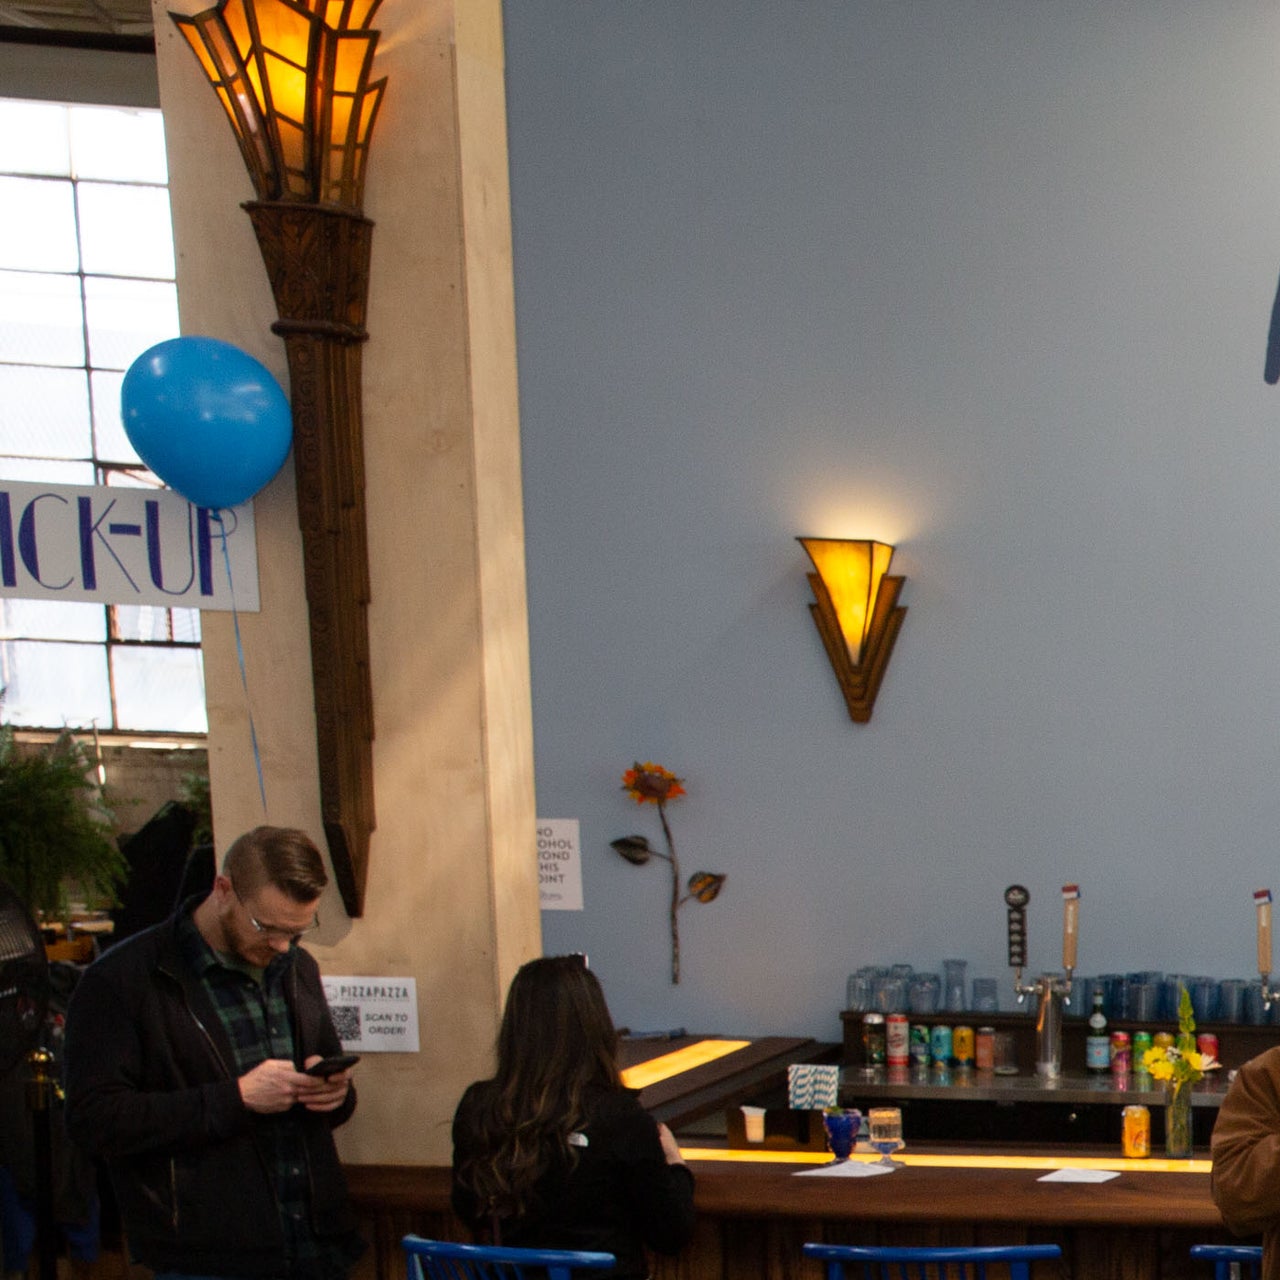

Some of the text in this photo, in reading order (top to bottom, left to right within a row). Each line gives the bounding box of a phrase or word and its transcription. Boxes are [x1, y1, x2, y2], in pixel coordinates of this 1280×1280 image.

[0, 490, 238, 597] ICK-UP
[537, 839, 573, 849] OHOL
[539, 863, 559, 872] HIS
[365, 1013, 408, 1022] SCAN TO
